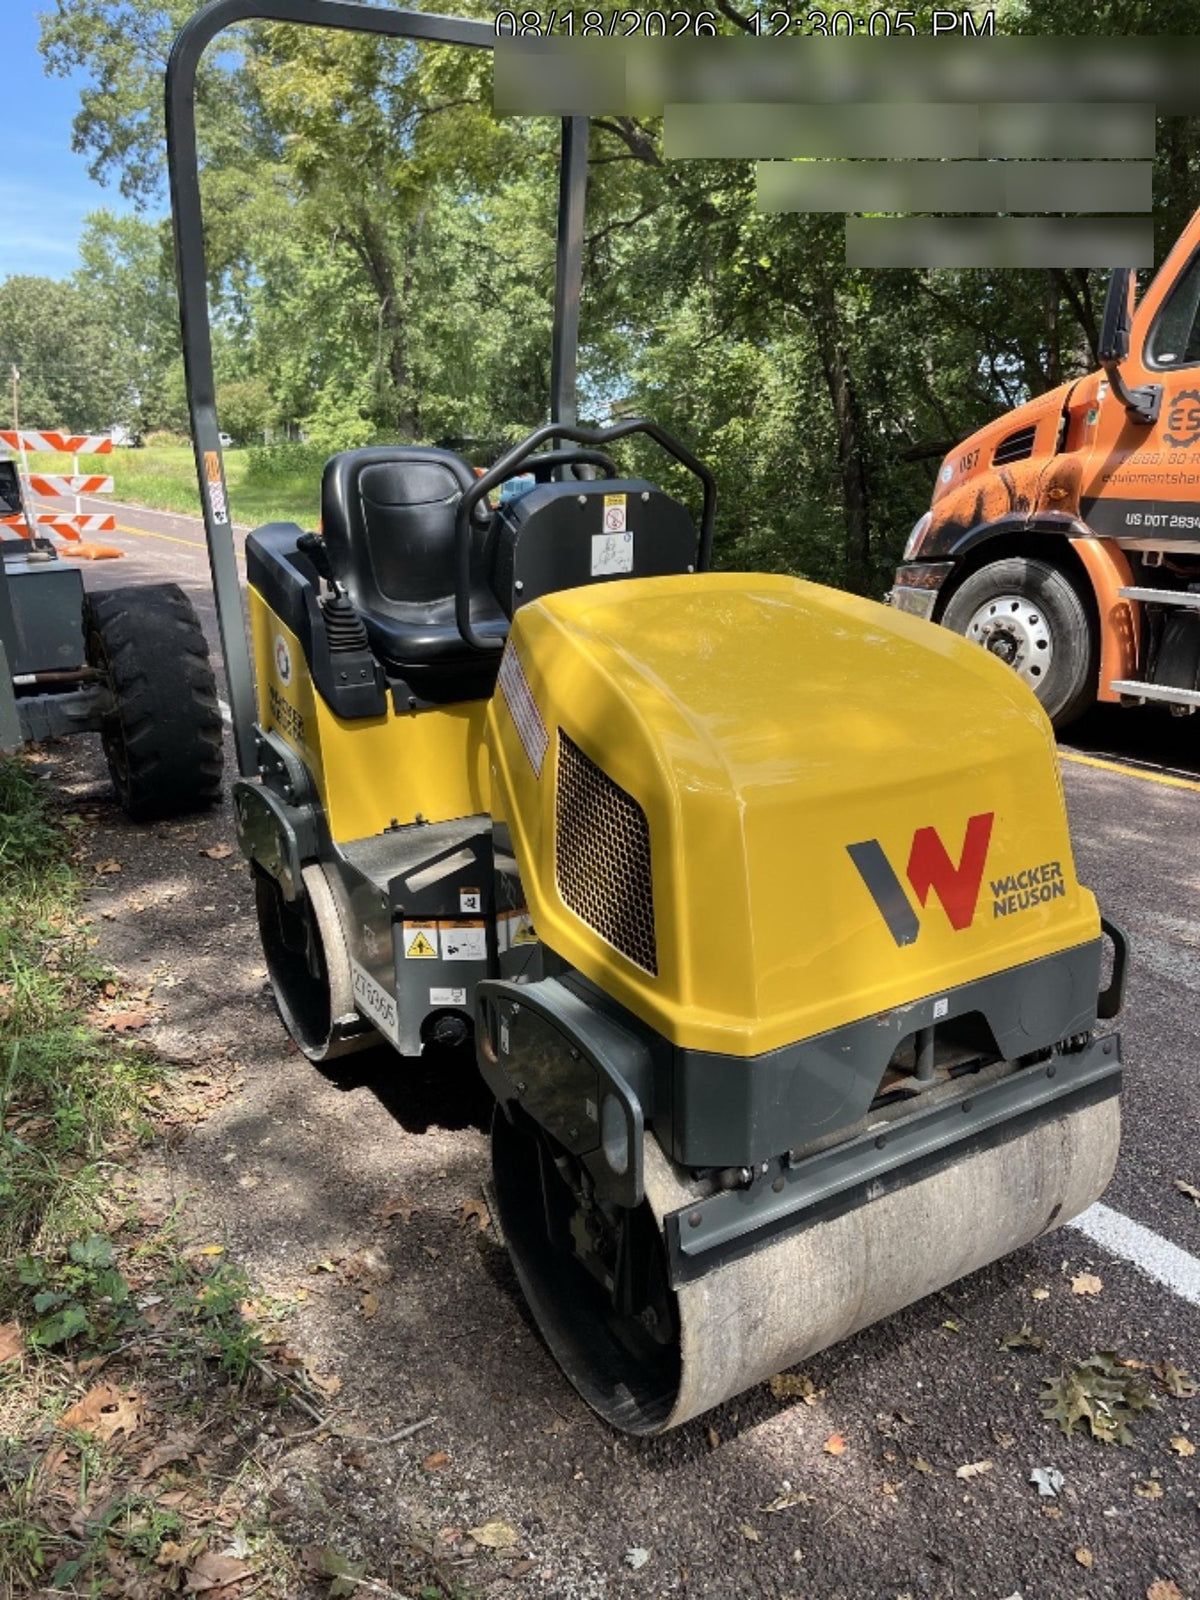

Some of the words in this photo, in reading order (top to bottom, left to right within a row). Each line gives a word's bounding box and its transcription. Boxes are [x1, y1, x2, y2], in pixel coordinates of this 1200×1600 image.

[1125, 513, 1142, 525] US
[1144, 514, 1168, 527] DOT
[990, 862, 1063, 898] WACKER
[993, 879, 1066, 919] NEUSON
